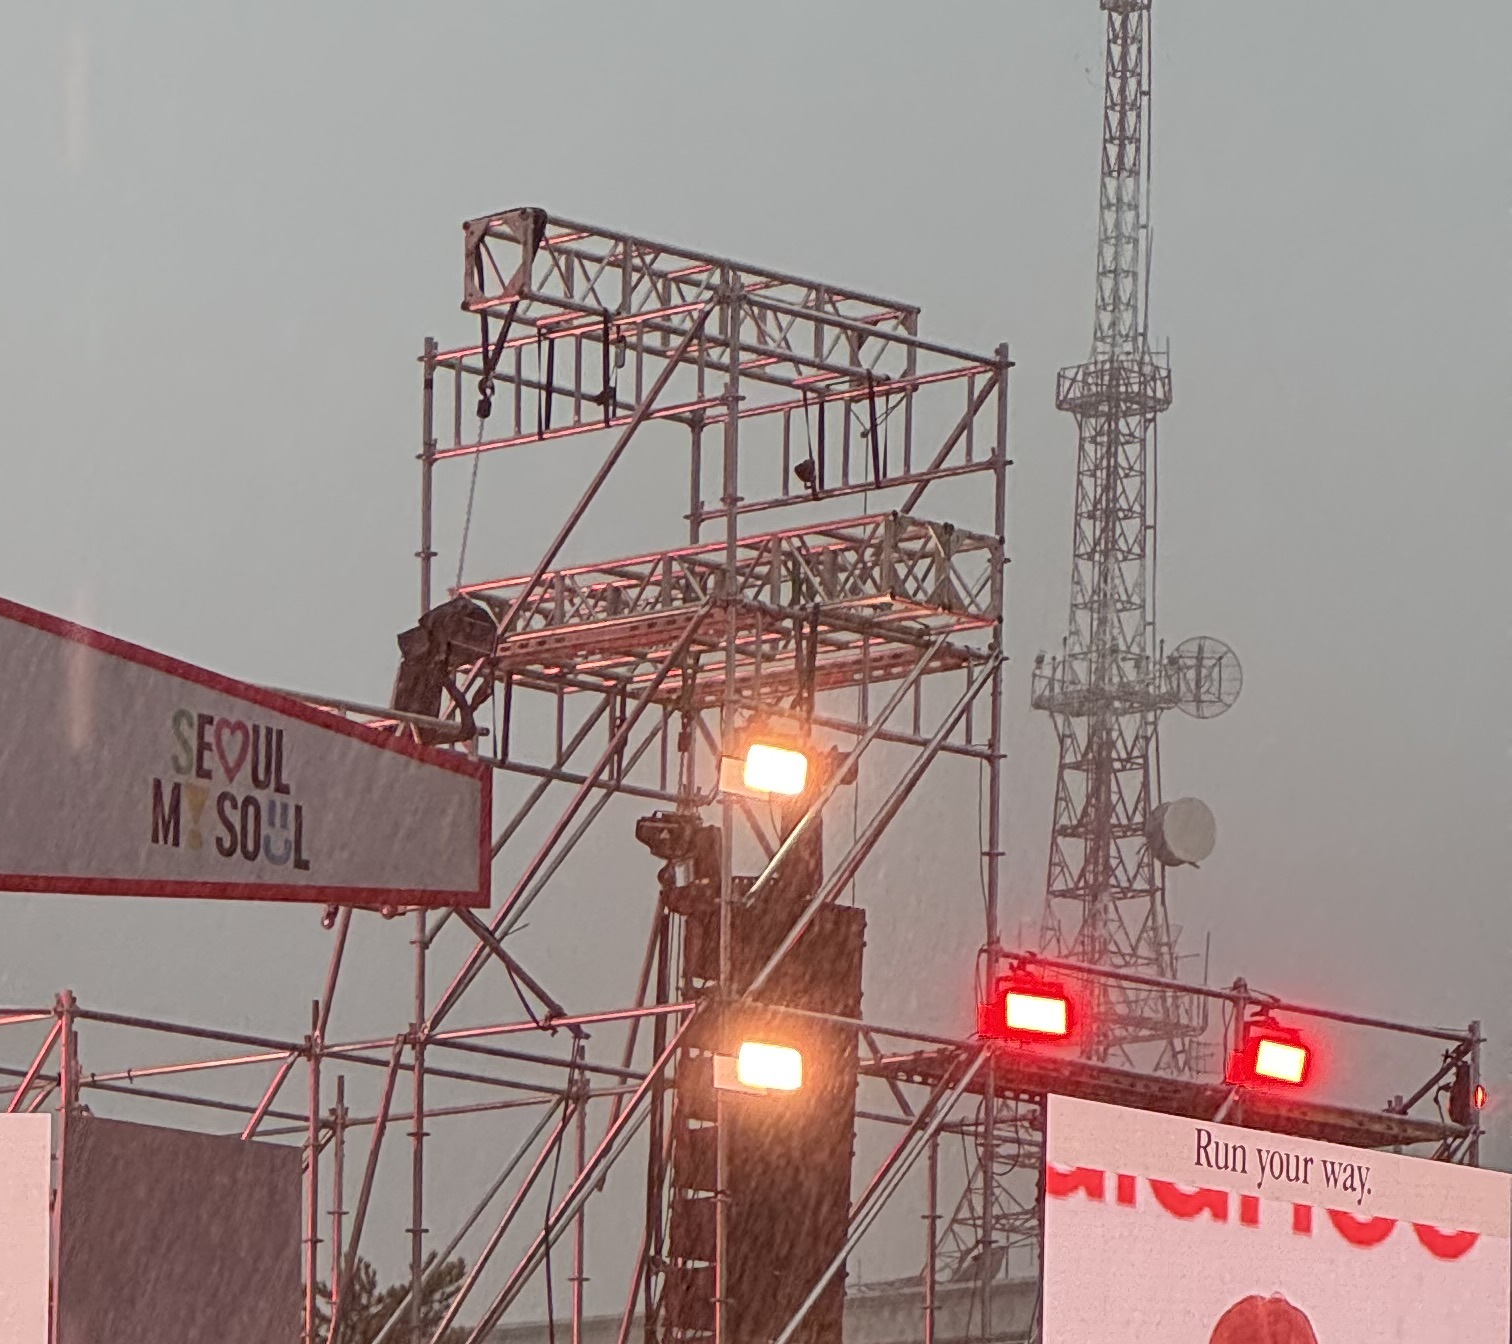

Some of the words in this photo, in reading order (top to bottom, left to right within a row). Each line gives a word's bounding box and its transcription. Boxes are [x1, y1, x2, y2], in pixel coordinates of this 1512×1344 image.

[1194, 1127, 1248, 1175] Run
[1256, 1147, 1314, 1190] your
[1320, 1159, 1372, 1206] way.
